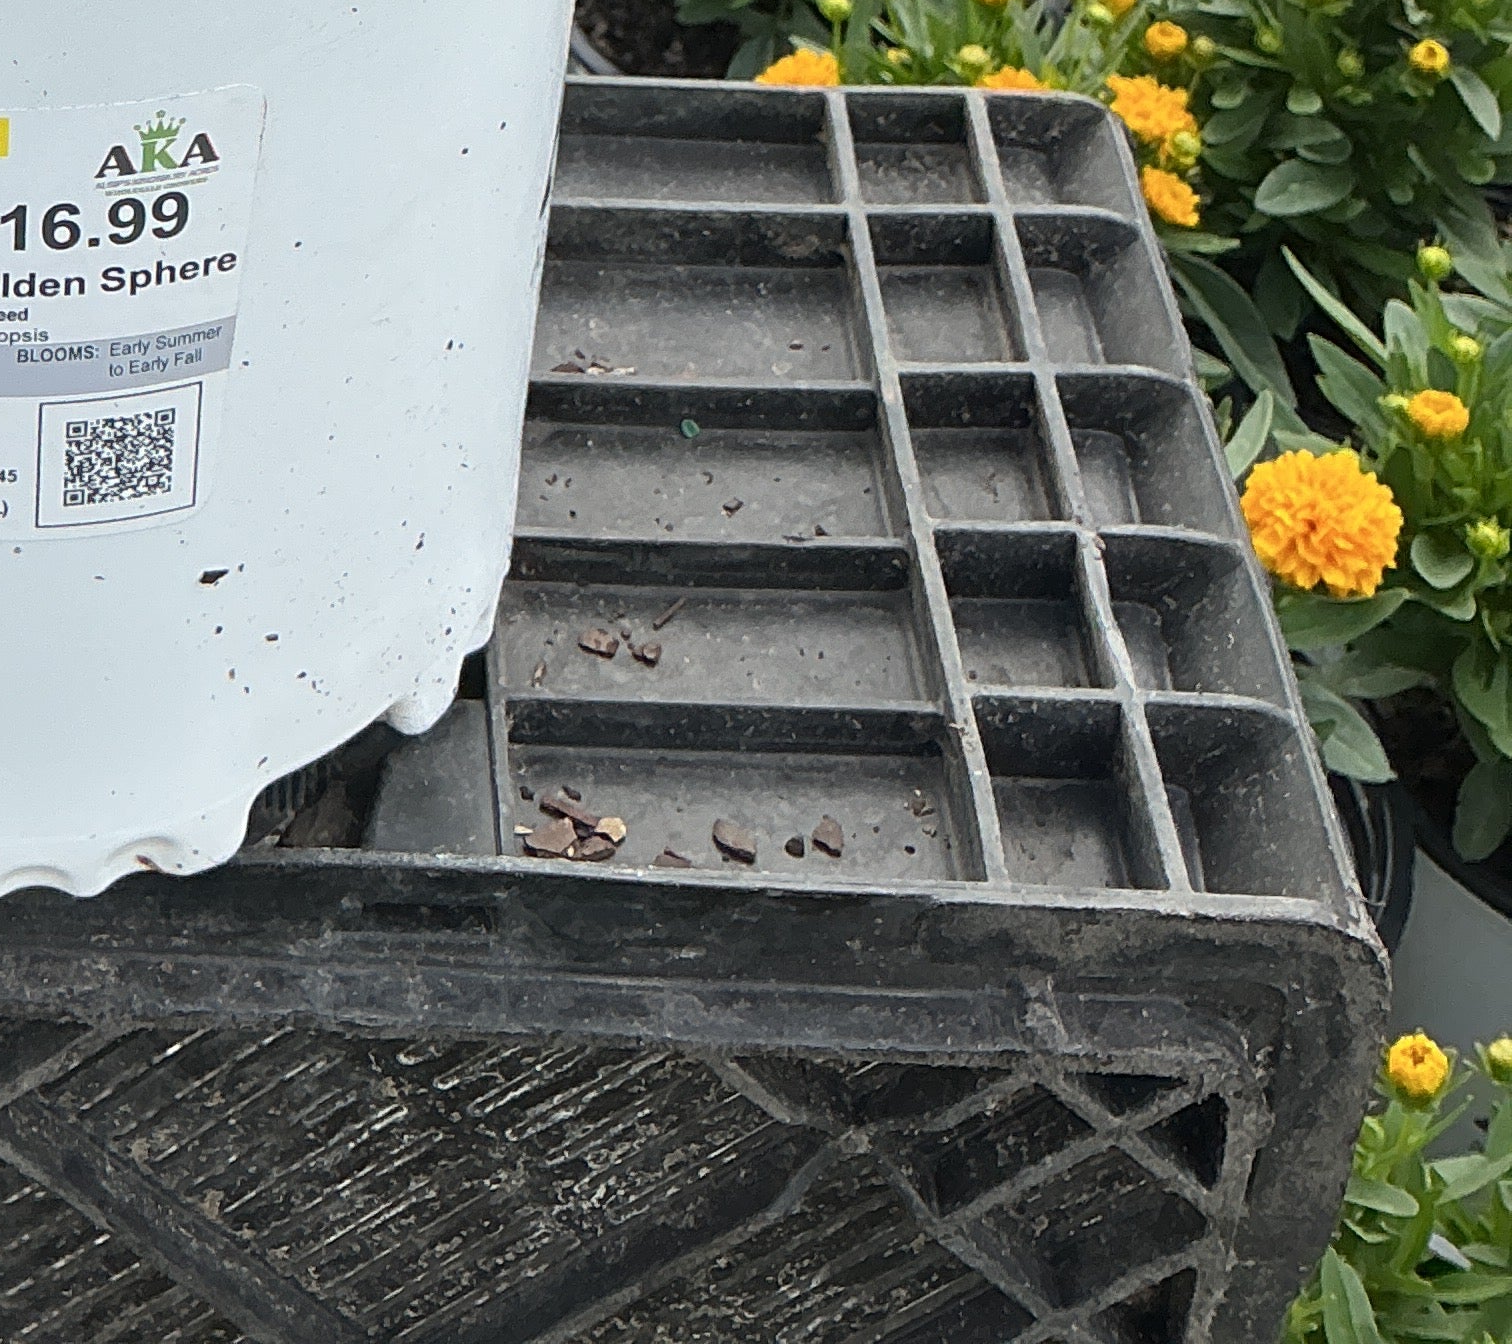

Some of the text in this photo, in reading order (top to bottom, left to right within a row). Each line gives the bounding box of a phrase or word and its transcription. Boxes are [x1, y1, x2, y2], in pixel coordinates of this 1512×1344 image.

[94, 132, 220, 179] AKA
[99, 251, 239, 297] Sphere
[17, 325, 223, 364] BLOOMS: Early Summer
[109, 347, 203, 378] to Early Fall
